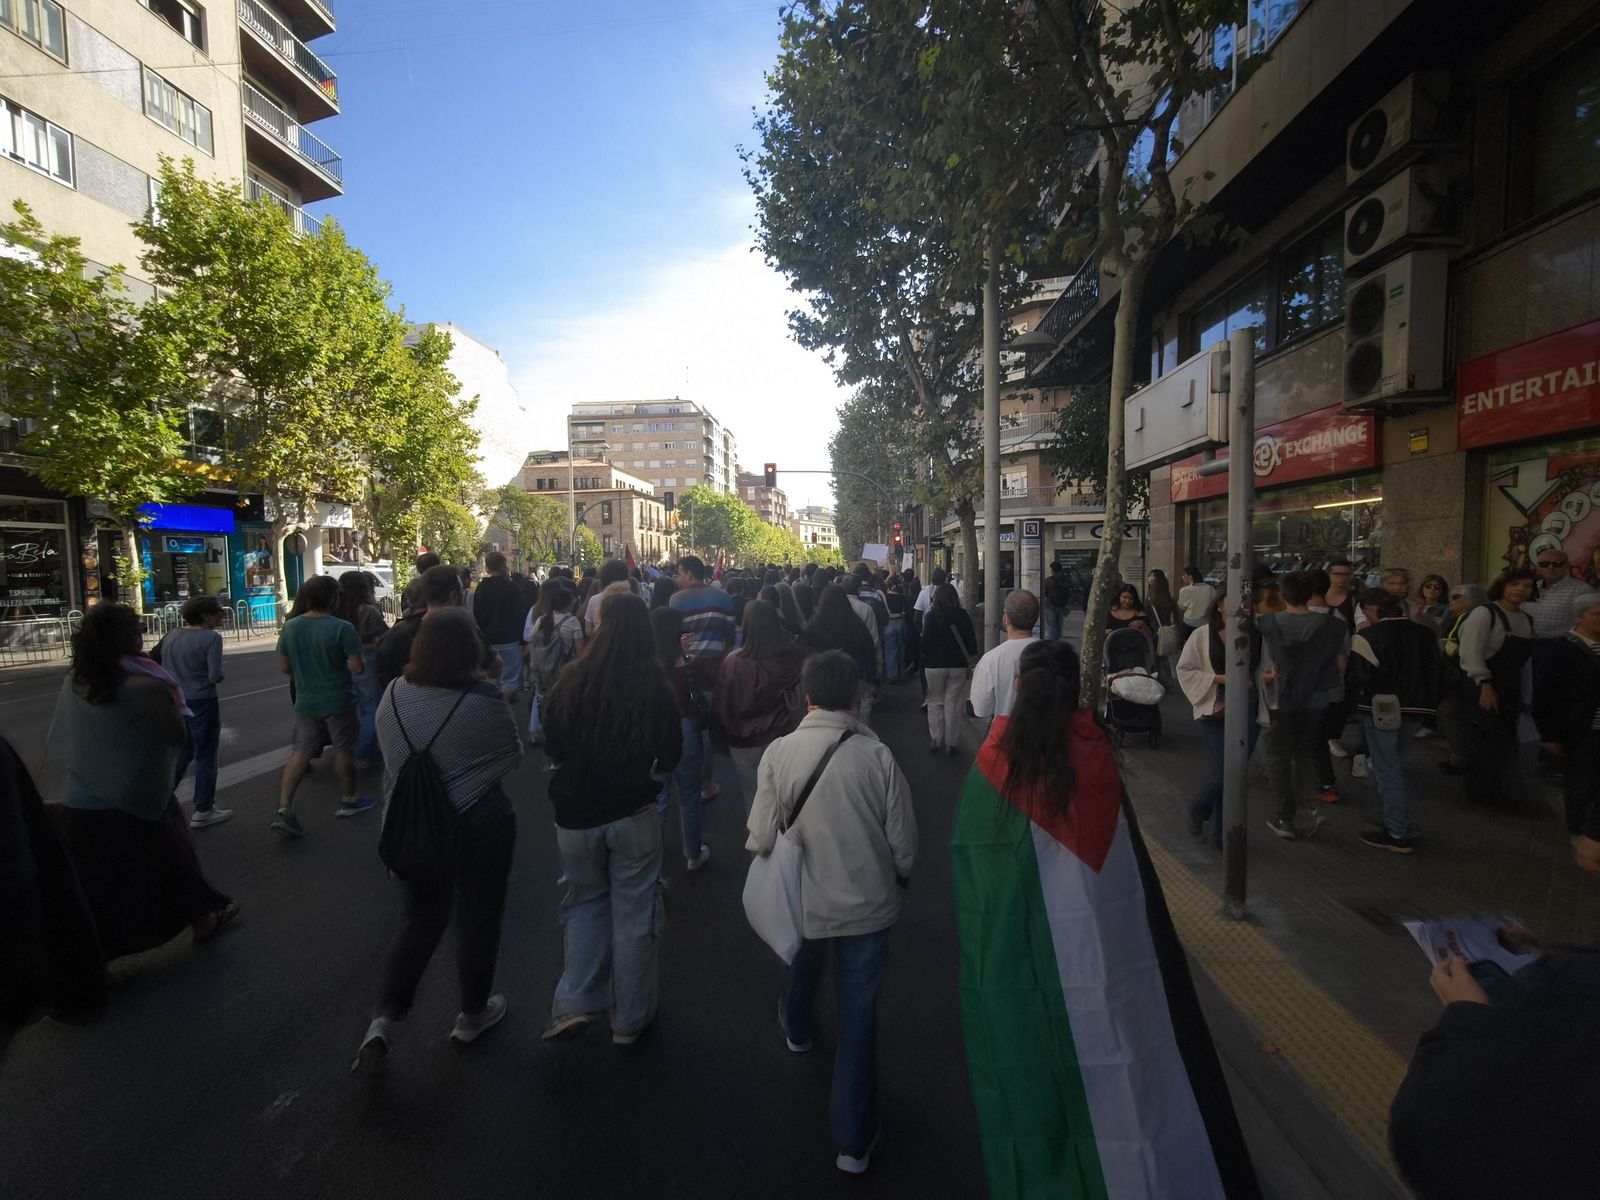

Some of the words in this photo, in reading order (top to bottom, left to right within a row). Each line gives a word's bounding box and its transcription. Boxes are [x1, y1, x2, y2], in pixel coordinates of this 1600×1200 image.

[1464, 358, 1600, 415] ENTERTAI
[1286, 421, 1367, 458] EXCHANGE
[9, 588, 37, 597] ESPACIO
[37, 588, 46, 596] DE
